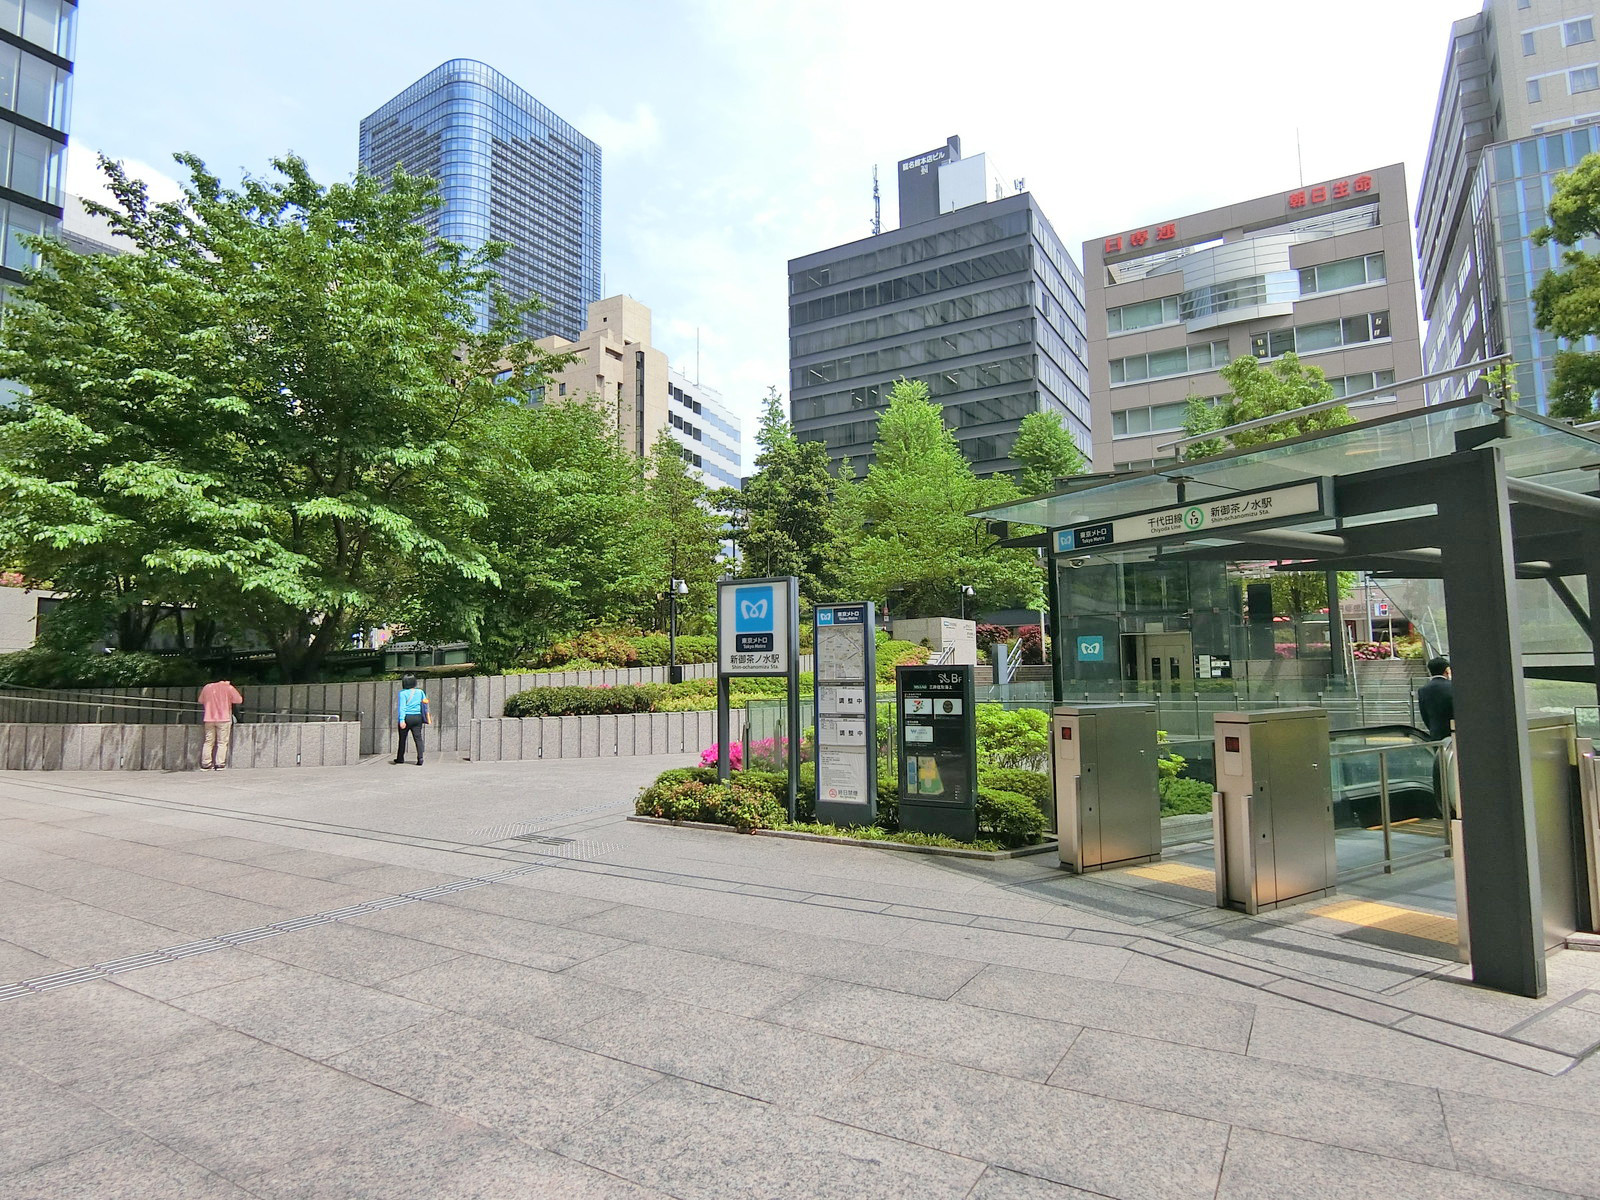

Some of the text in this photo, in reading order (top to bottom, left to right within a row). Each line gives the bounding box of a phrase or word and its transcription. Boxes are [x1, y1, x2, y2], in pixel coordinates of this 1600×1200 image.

[1289, 175, 1372, 209] 朝日生命
[1105, 223, 1176, 253] 日専連
[1210, 497, 1272, 517] 新御茶ノ水駅
[1191, 510, 1196, 518] C
[1211, 512, 1258, 523] Shin-ochanomizu
[1147, 513, 1183, 527] 千代田線
[1189, 517, 1199, 525] 12
[1080, 528, 1107, 539] 東京メトロ
[730, 654, 780, 664] 新御茶ノ水駅
